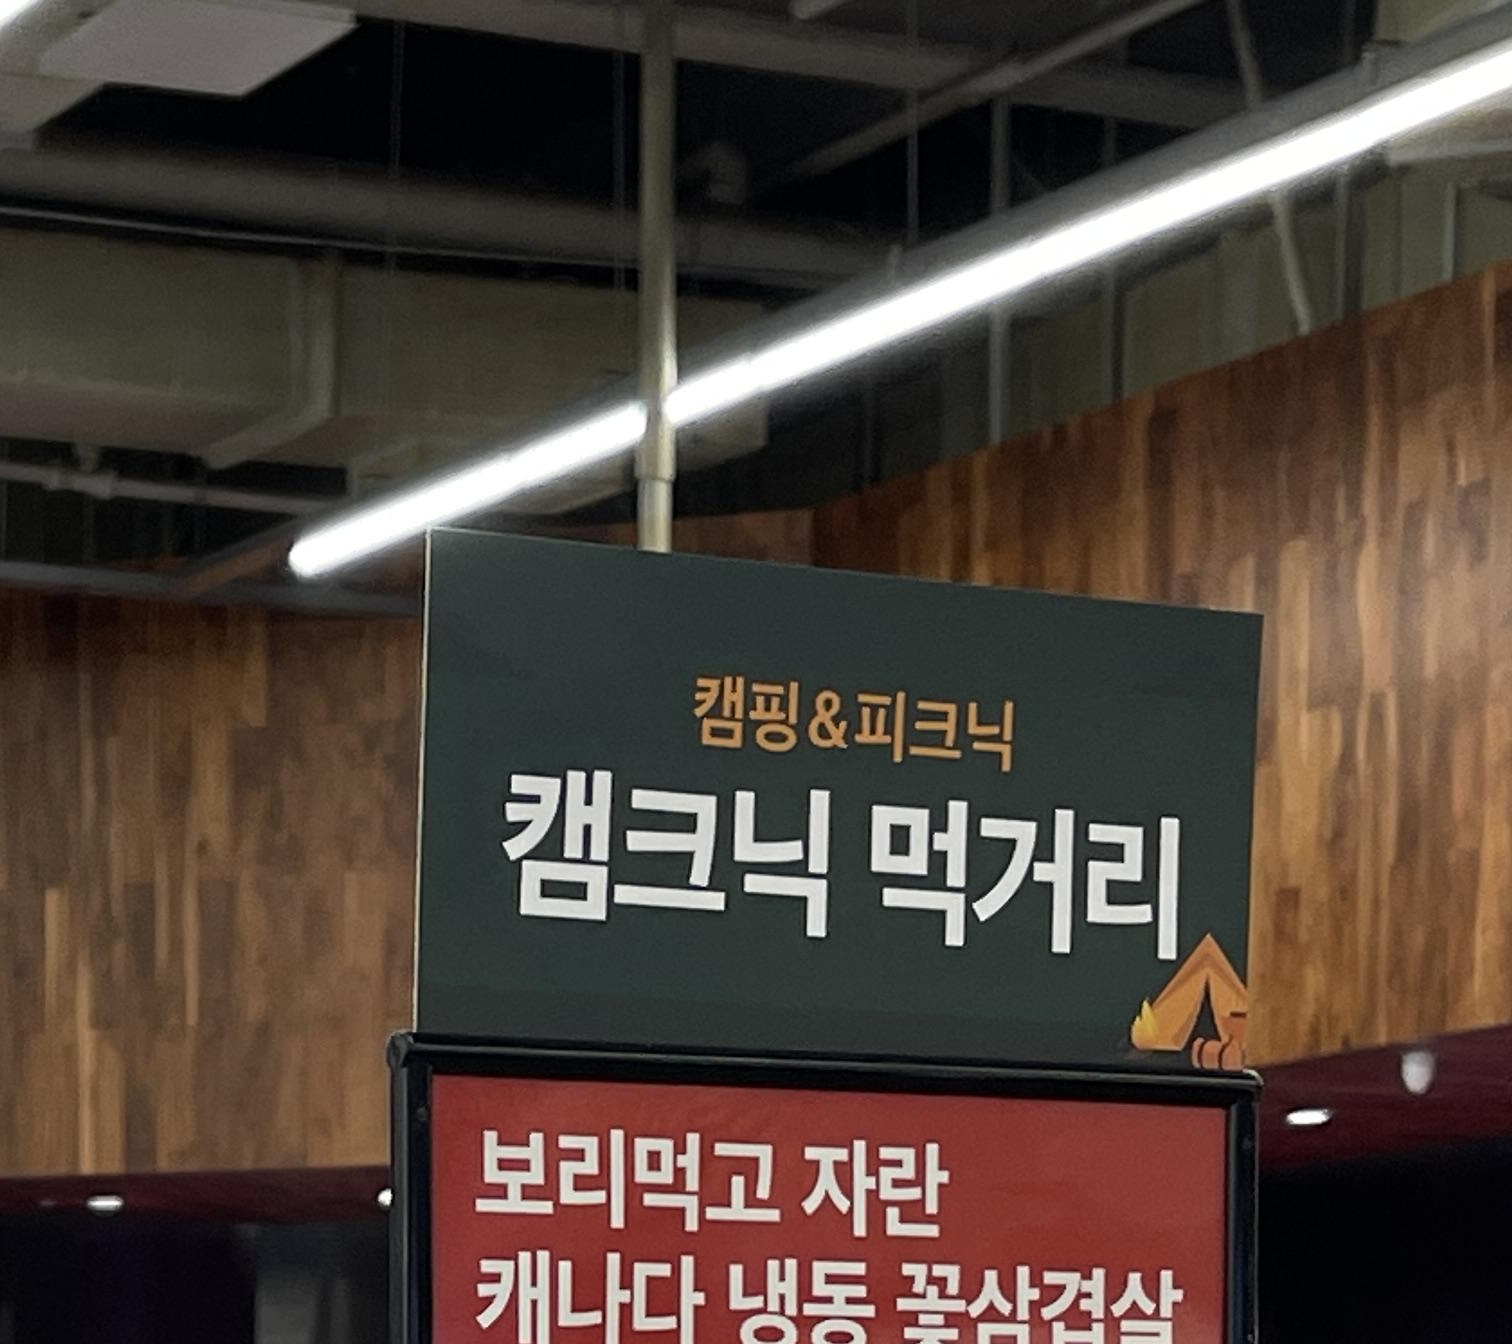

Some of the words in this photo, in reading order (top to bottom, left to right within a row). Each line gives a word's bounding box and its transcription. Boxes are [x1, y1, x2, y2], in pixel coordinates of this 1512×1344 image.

[693, 674, 1016, 773] 캠핑&피크닉
[501, 768, 831, 938] 캠크닉
[870, 798, 1180, 961] 먹거리
[474, 1128, 782, 1232] 보리먹고
[800, 1139, 950, 1238] 자란
